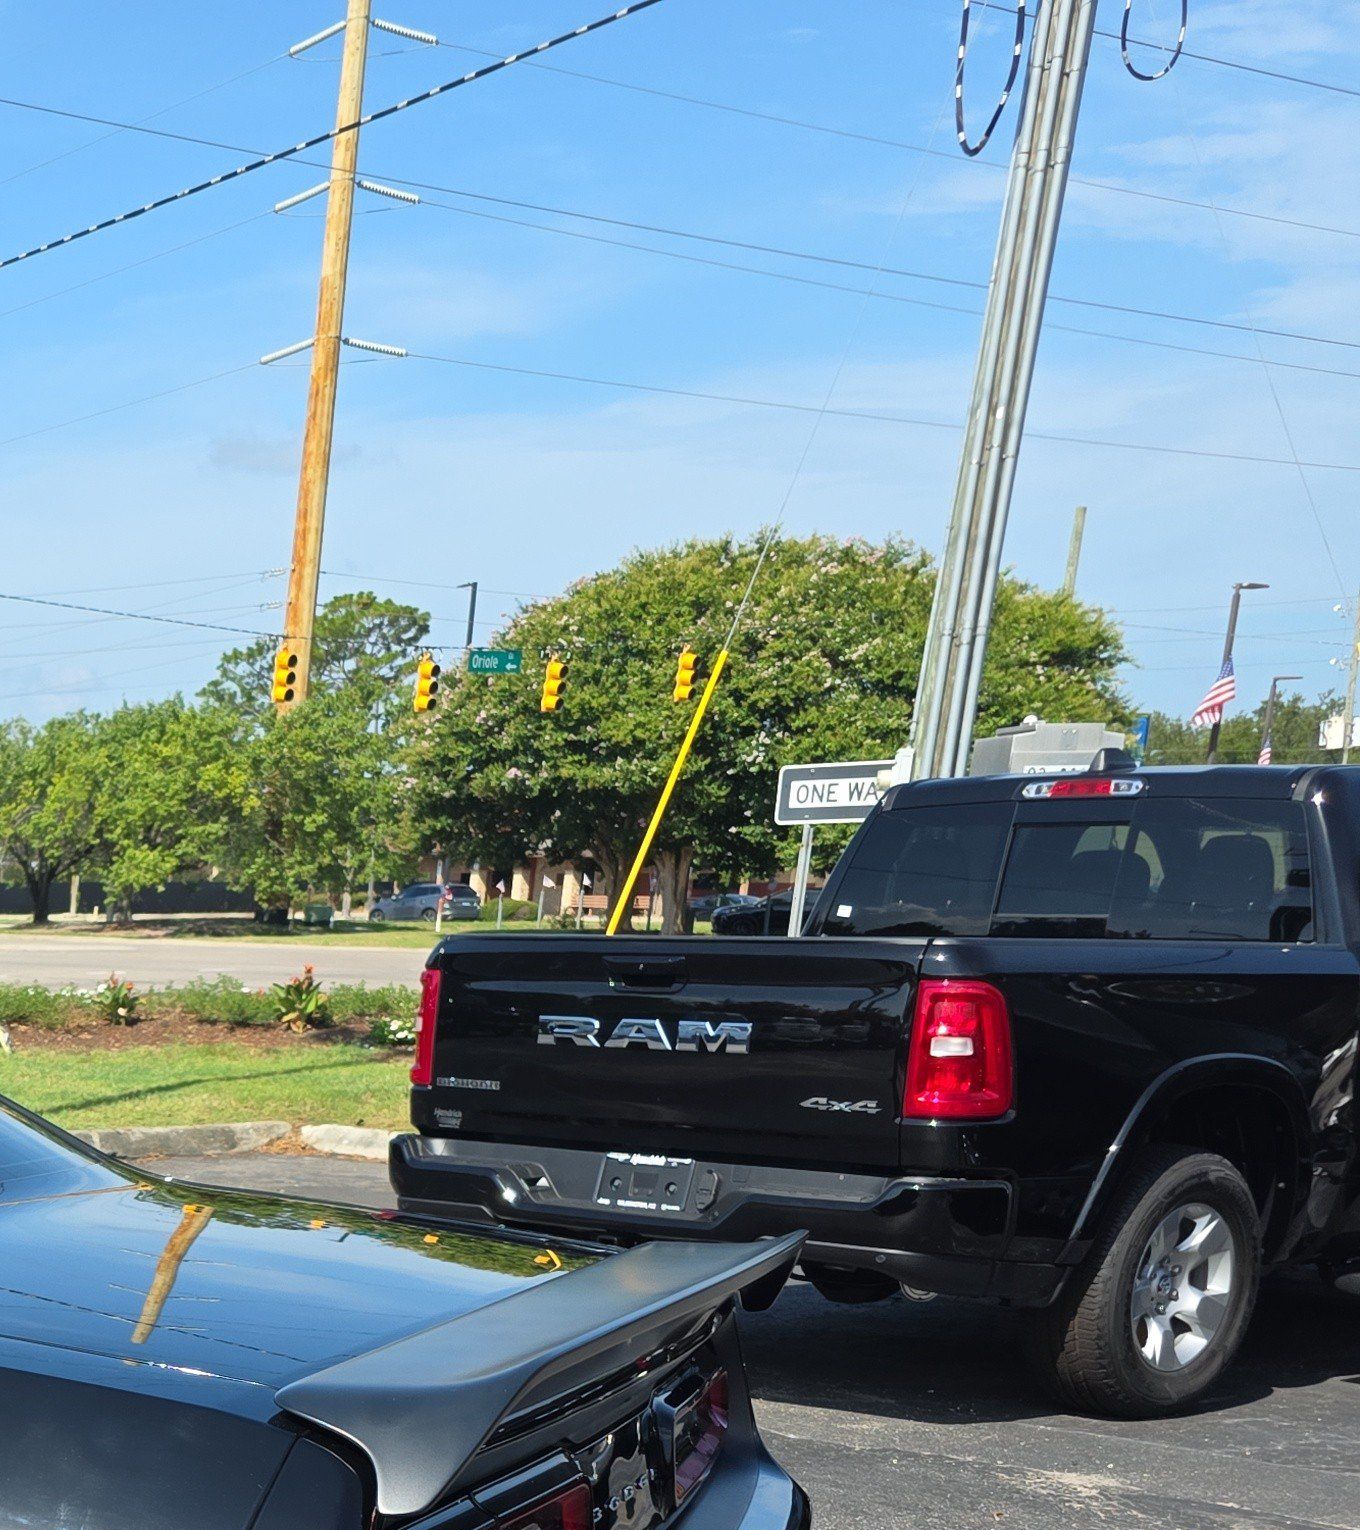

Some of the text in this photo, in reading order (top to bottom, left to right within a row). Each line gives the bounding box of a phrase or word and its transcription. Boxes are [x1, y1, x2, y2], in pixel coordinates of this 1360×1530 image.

[472, 654, 499, 669] Oriole
[796, 781, 879, 803] ONE WA
[537, 1014, 753, 1054] RAM
[799, 1097, 882, 1115] 4x4
